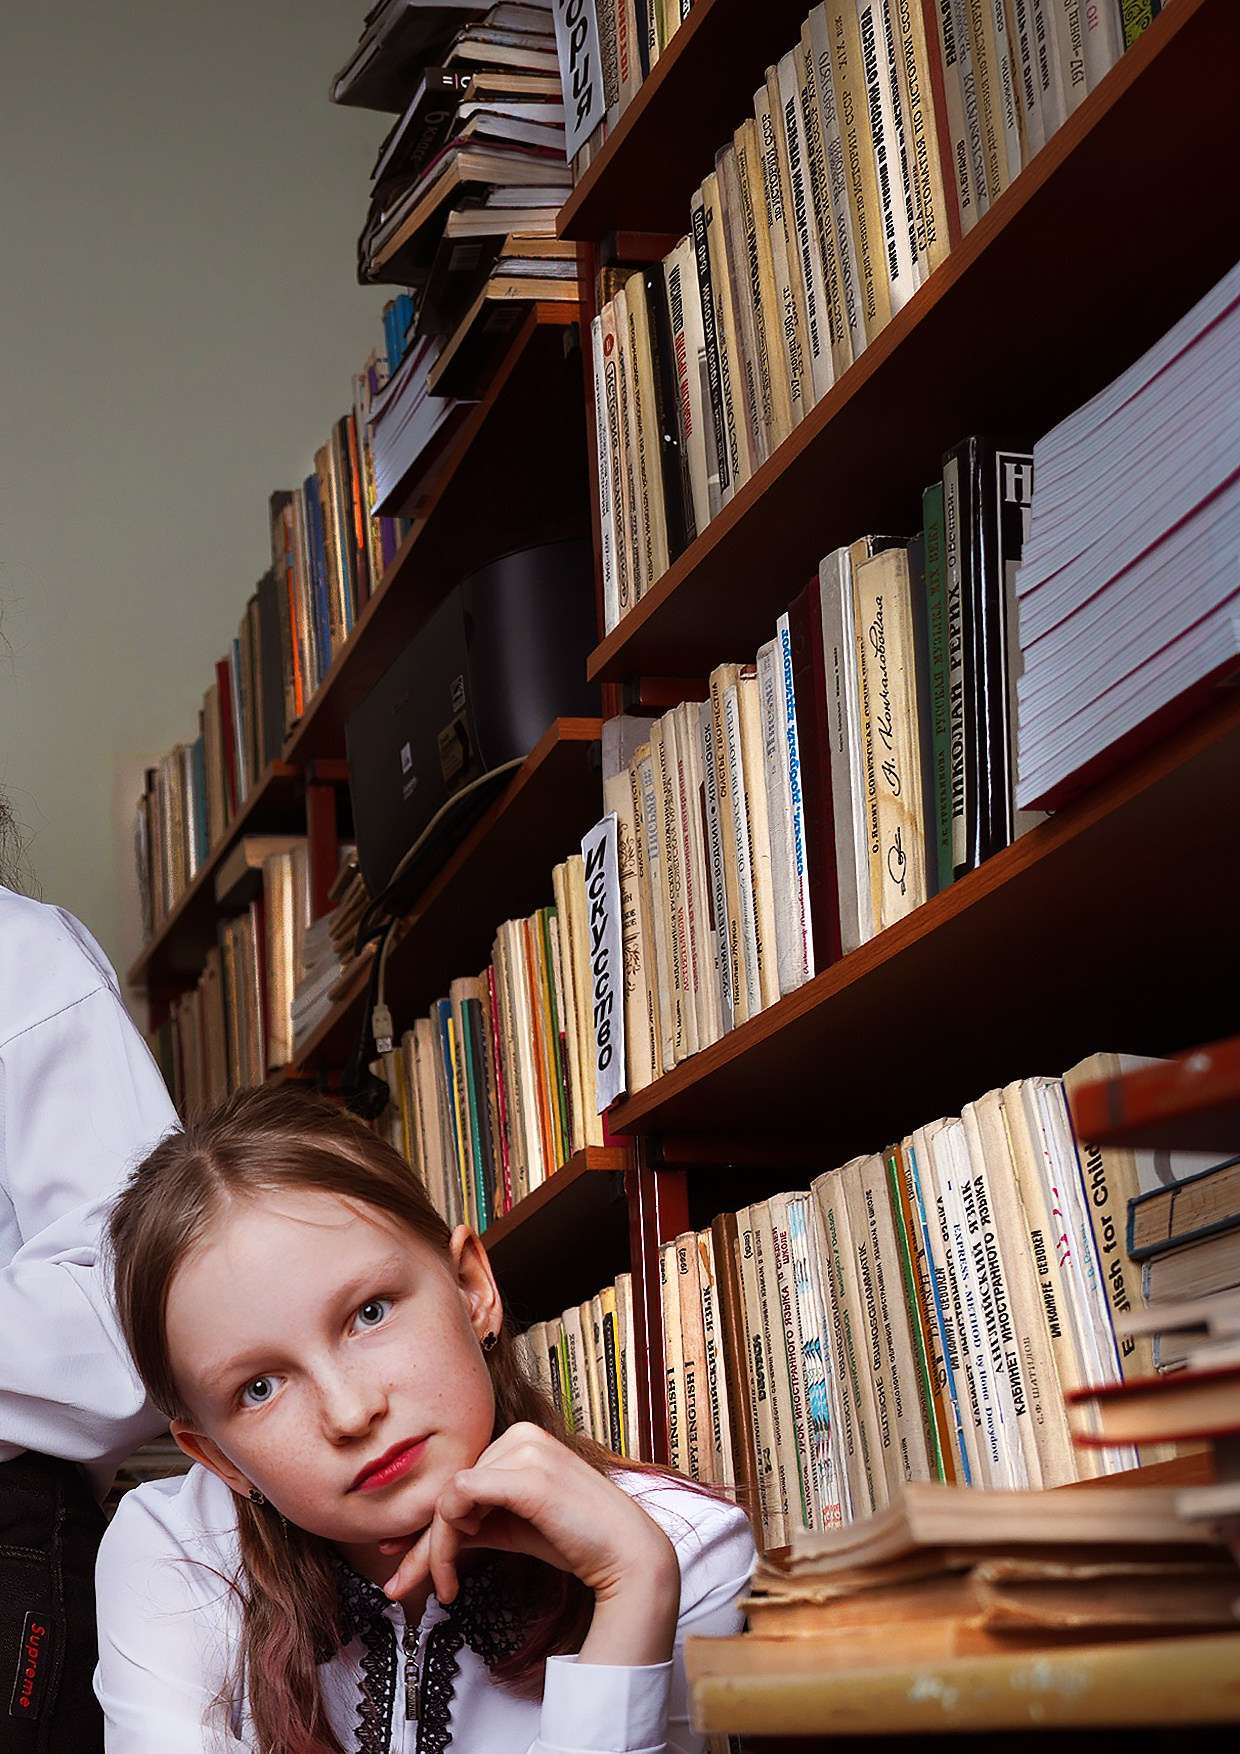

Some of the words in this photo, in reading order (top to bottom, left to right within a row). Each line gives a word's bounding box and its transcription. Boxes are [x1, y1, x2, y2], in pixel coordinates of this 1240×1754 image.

[836, 39, 848, 70] XIX
[859, 5, 878, 83] ОТЕЧЕСТВА
[902, 35, 922, 107] ИСТОРИИ
[818, 50, 837, 129] 1640-1870
[841, 89, 855, 125] СССР
[867, 84, 885, 147] ИСТОРИИ
[910, 110, 925, 133] ПО
[762, 114, 775, 146] СССР
[781, 95, 801, 168] ОТЕЧЕСТВА
[963, 69, 987, 199] ХРЕСТОМАТИЯ
[847, 129, 864, 196] ИСТОРИИ
[915, 136, 937, 248] ХРЕСТОМАТИЯ
[790, 169, 807, 229] ИСТОРИИ
[693, 211, 709, 275] 1640-1870
[746, 233, 761, 308] ИСТОРИИ
[667, 262, 686, 331] ФАШИЗМА
[701, 283, 714, 340] ИСТОРИИ
[675, 331, 688, 375] ПРОТИВ
[706, 343, 719, 389] НОВОЙ
[927, 520, 940, 563] ВЕКА
[928, 568, 940, 596] XIX
[929, 602, 943, 664] МУЗЫКА
[947, 581, 963, 672] РЕРИХ
[711, 681, 725, 751] ТВОРЧЕСТВА
[933, 671, 947, 735] РУССКАЯ
[718, 754, 728, 798] СЧАСТЬЕ
[786, 724, 802, 804] добрый
[642, 790, 659, 861] Письма
[711, 818, 726, 937] ПЕТРОВ-ВОДКИН
[719, 942, 729, 998] КУЗЬМА
[959, 1180, 980, 1235] ЯЗЫК
[973, 1175, 993, 1226] ЯЗЫКА
[778, 1230, 790, 1265] ШКОЛЕ
[1030, 1229, 1050, 1275] GEBOREN
[1097, 1214, 1119, 1252] for
[781, 1285, 794, 1326] ЯЗЫКА
[971, 1241, 1005, 1374] АНГЛИЙСКИЙ
[983, 1231, 1014, 1342] ИНОСТРАННОГО
[1040, 1280, 1059, 1322] KAMPFE
[964, 1290, 982, 1348] METHOD
[785, 1329, 803, 1420] ИНОСТРАННОГО
[1006, 1350, 1026, 1416] КАБИНЕТ
[668, 1383, 679, 1449] ENGLISH
[685, 1372, 698, 1445] ENGLISH
[794, 1422, 806, 1455] УРОК
[874, 1377, 891, 1448] DEUTSCHE
[19, 1622, 46, 1708] Supreme
